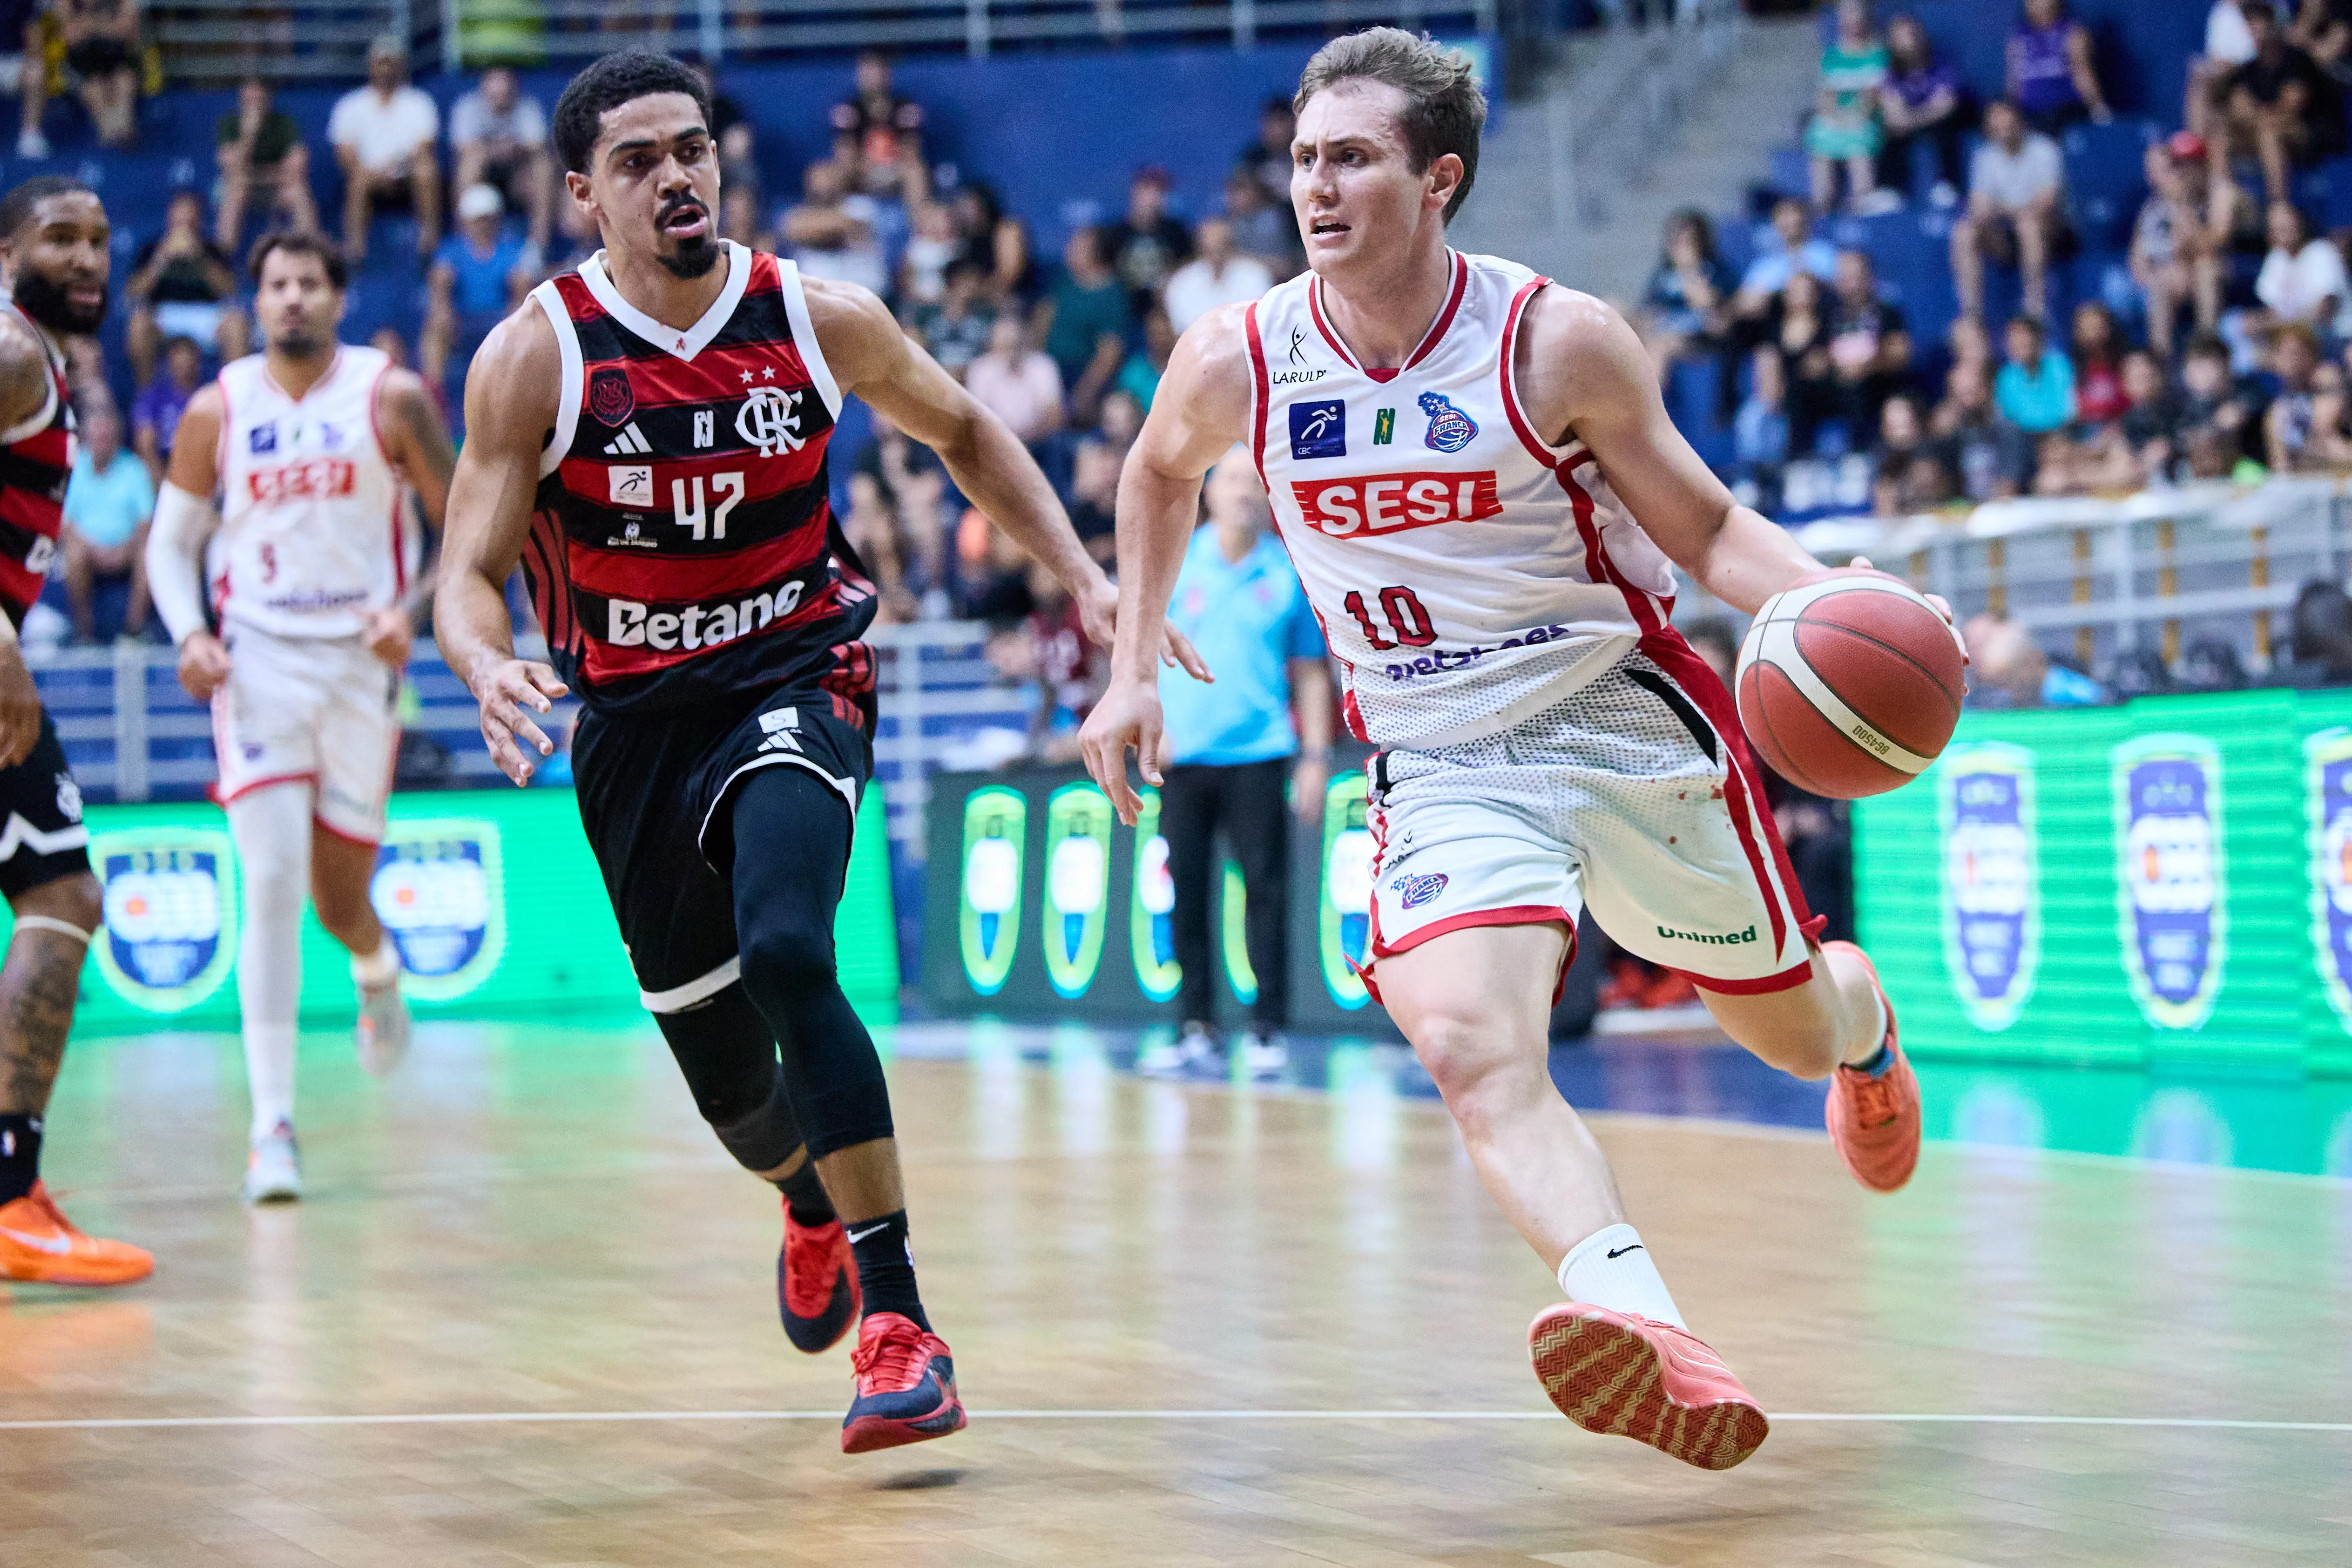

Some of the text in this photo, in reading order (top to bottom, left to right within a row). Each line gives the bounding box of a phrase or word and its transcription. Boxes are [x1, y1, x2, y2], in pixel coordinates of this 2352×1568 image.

[1273, 370, 1325, 384] LARULP
[1434, 421, 1468, 435] FRANCA
[1439, 413, 1456, 423] SESI
[672, 472, 744, 541] 47
[1317, 480, 1475, 535] SESI
[608, 580, 804, 650] Betano
[1344, 585, 1438, 650] 10
[1852, 725, 1890, 755] BG4500
[1657, 925, 1757, 944] Unimed
